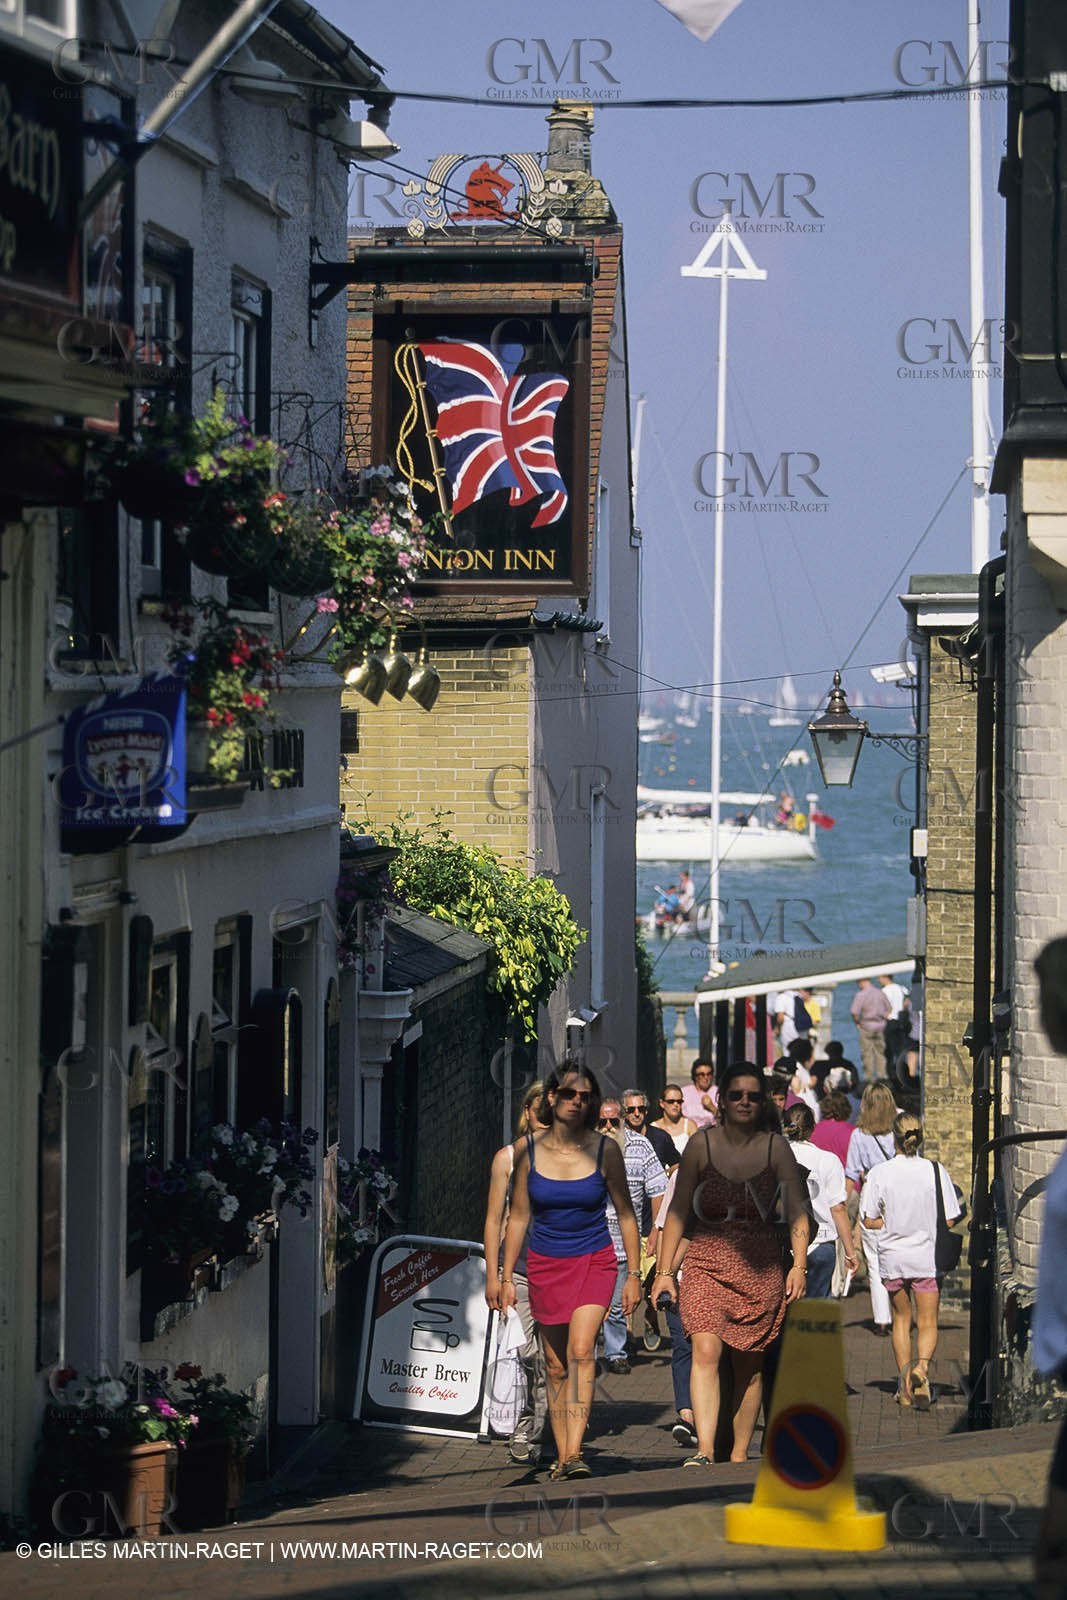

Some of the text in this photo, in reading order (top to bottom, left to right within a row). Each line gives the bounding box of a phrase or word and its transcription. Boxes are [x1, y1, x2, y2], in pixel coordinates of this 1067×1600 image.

[423, 549, 556, 571] NION INN
[76, 804, 172, 820] Ice Cream
[384, 1252, 433, 1293] Fresh Coffee
[390, 1266, 439, 1302] Served Here
[380, 1358, 471, 1383] Master Brew
[388, 1382, 459, 1401] Quality Coffee
